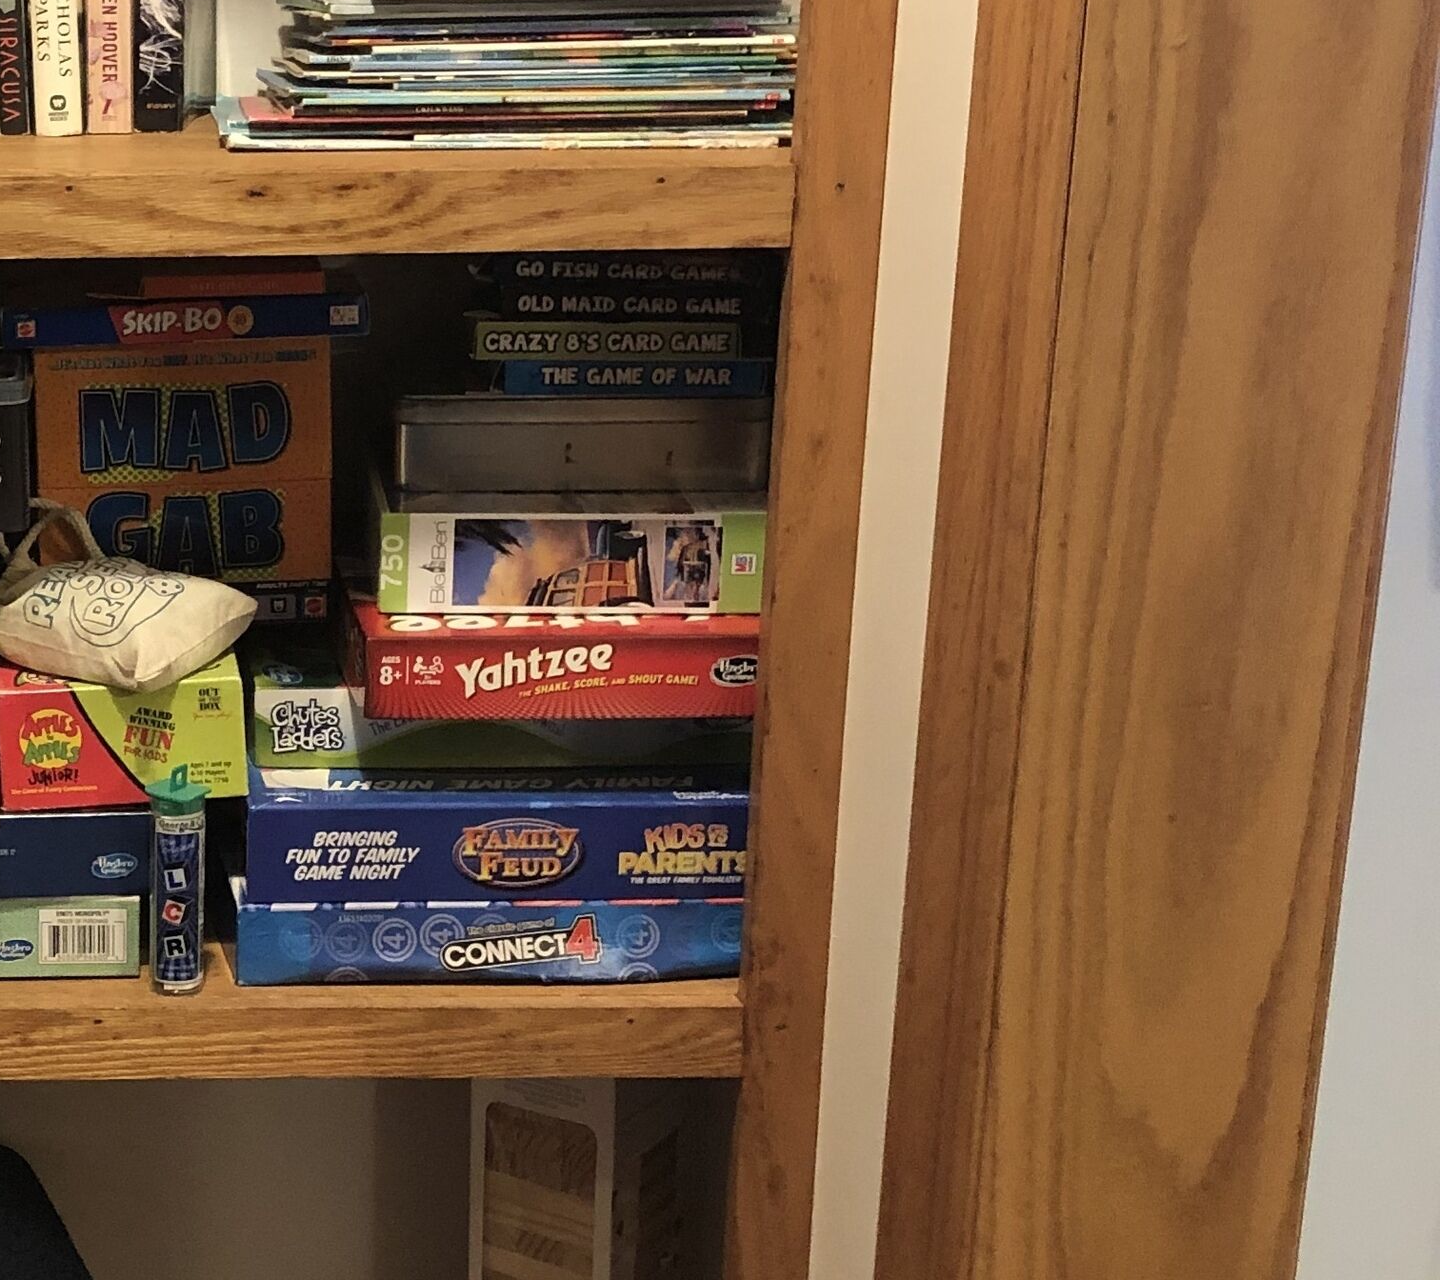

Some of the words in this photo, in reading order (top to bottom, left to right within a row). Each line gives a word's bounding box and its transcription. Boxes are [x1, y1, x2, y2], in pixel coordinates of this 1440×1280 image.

[102, 21, 118, 83] HOOVER
[515, 261, 545, 278] GO
[552, 261, 600, 278] FISH
[607, 263, 664, 280] CARD
[670, 264, 728, 281] GAME
[517, 295, 555, 313] OLD
[561, 296, 616, 313] MAID
[623, 296, 678, 314] CARD
[685, 298, 742, 316] GAME
[122, 308, 223, 336] SKIP-BO
[484, 332, 559, 353] CRAZY
[606, 332, 664, 352] CARD
[670, 332, 729, 352] GAME
[541, 366, 578, 385] THE
[586, 366, 644, 385] GAME
[651, 367, 676, 385] OF
[684, 367, 732, 386] WAR
[79, 380, 292, 473] MAD
[86, 489, 285, 577] GAB
[431, 521, 448, 560] Ben
[380, 534, 404, 590] 750
[379, 666, 402, 686] 8+
[455, 643, 615, 700] Yahtzee
[533, 683, 572, 696] SHAKE,
[573, 677, 609, 689] SCORE,
[628, 673, 664, 686] SHOUT
[665, 673, 699, 686] GAME!
[135, 707, 173, 720] AWARD
[199, 702, 221, 711] BOX
[270, 697, 339, 728] Chutes
[21, 714, 81, 741] APPLES
[129, 715, 176, 732] WINNING
[123, 725, 176, 752] FUN
[271, 725, 343, 754] Ladders
[23, 740, 81, 766] APPLES
[445, 777, 545, 791] GAME
[313, 831, 398, 848] BRINGING
[462, 825, 580, 856] FAMILY
[643, 823, 705, 853] KIDS
[96, 856, 135, 868] Hasbro
[285, 849, 323, 865] FUN
[328, 848, 351, 864] TO
[354, 847, 420, 864] FAMILY
[476, 853, 561, 882] FEUD
[618, 850, 747, 876] PARENTS
[166, 871, 184, 889] L
[294, 865, 346, 881] GAME
[348, 864, 405, 881] NIGHT
[164, 902, 183, 920] C
[166, 939, 185, 957] R
[444, 933, 568, 968] CONNECT
[565, 915, 599, 962] 4
